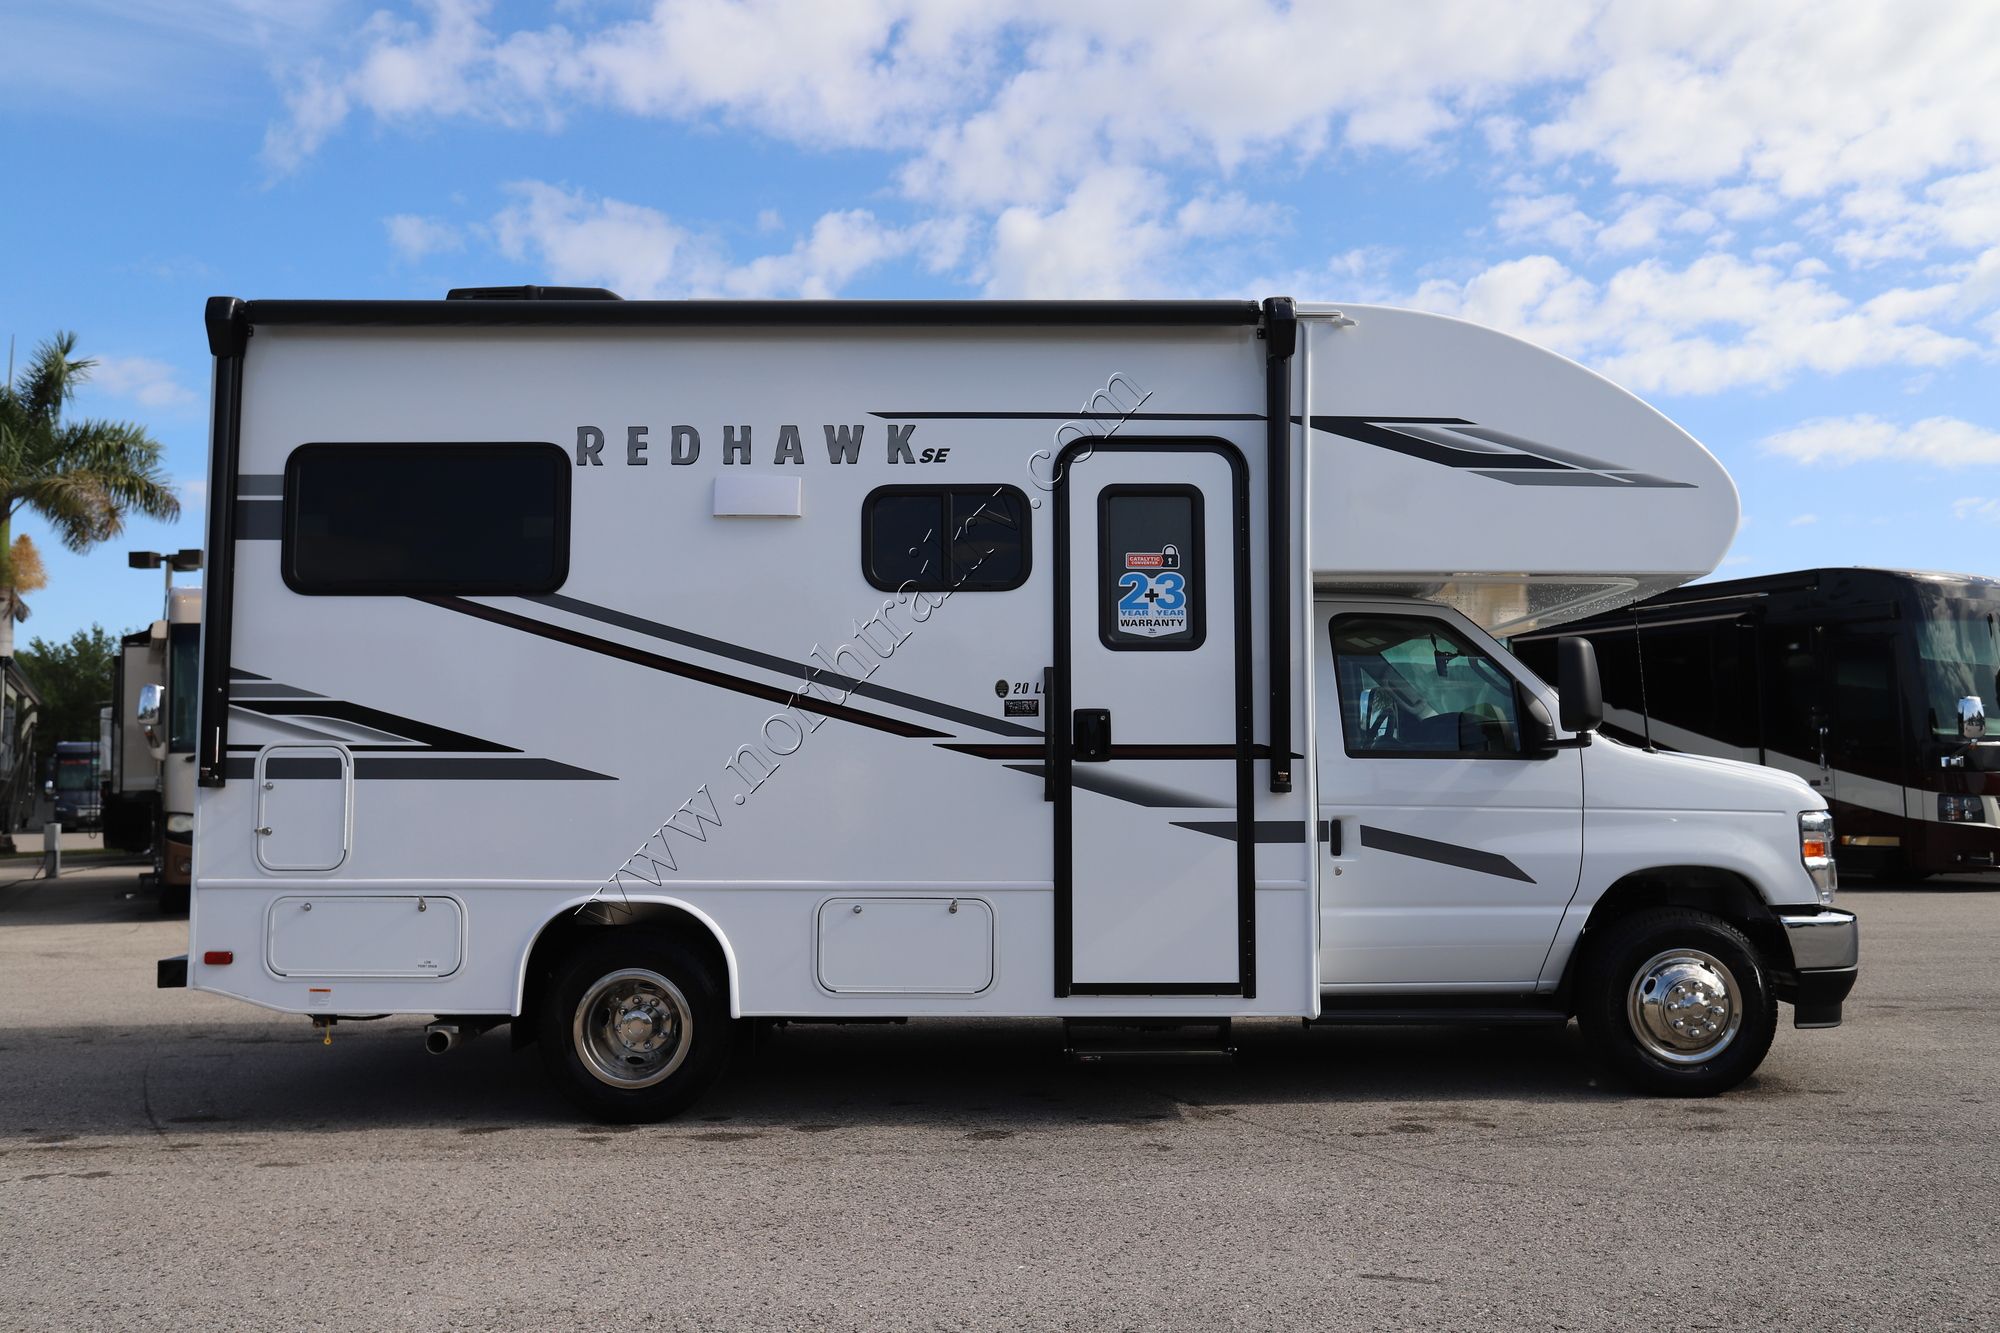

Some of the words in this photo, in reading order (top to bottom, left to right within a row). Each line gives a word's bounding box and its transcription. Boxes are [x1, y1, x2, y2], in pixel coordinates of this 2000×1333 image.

[576, 424, 916, 466] REDHAWK
[919, 447, 951, 464] SE
[1120, 619, 1184, 627] WARRANTY
[1013, 682, 1029, 694] 20
